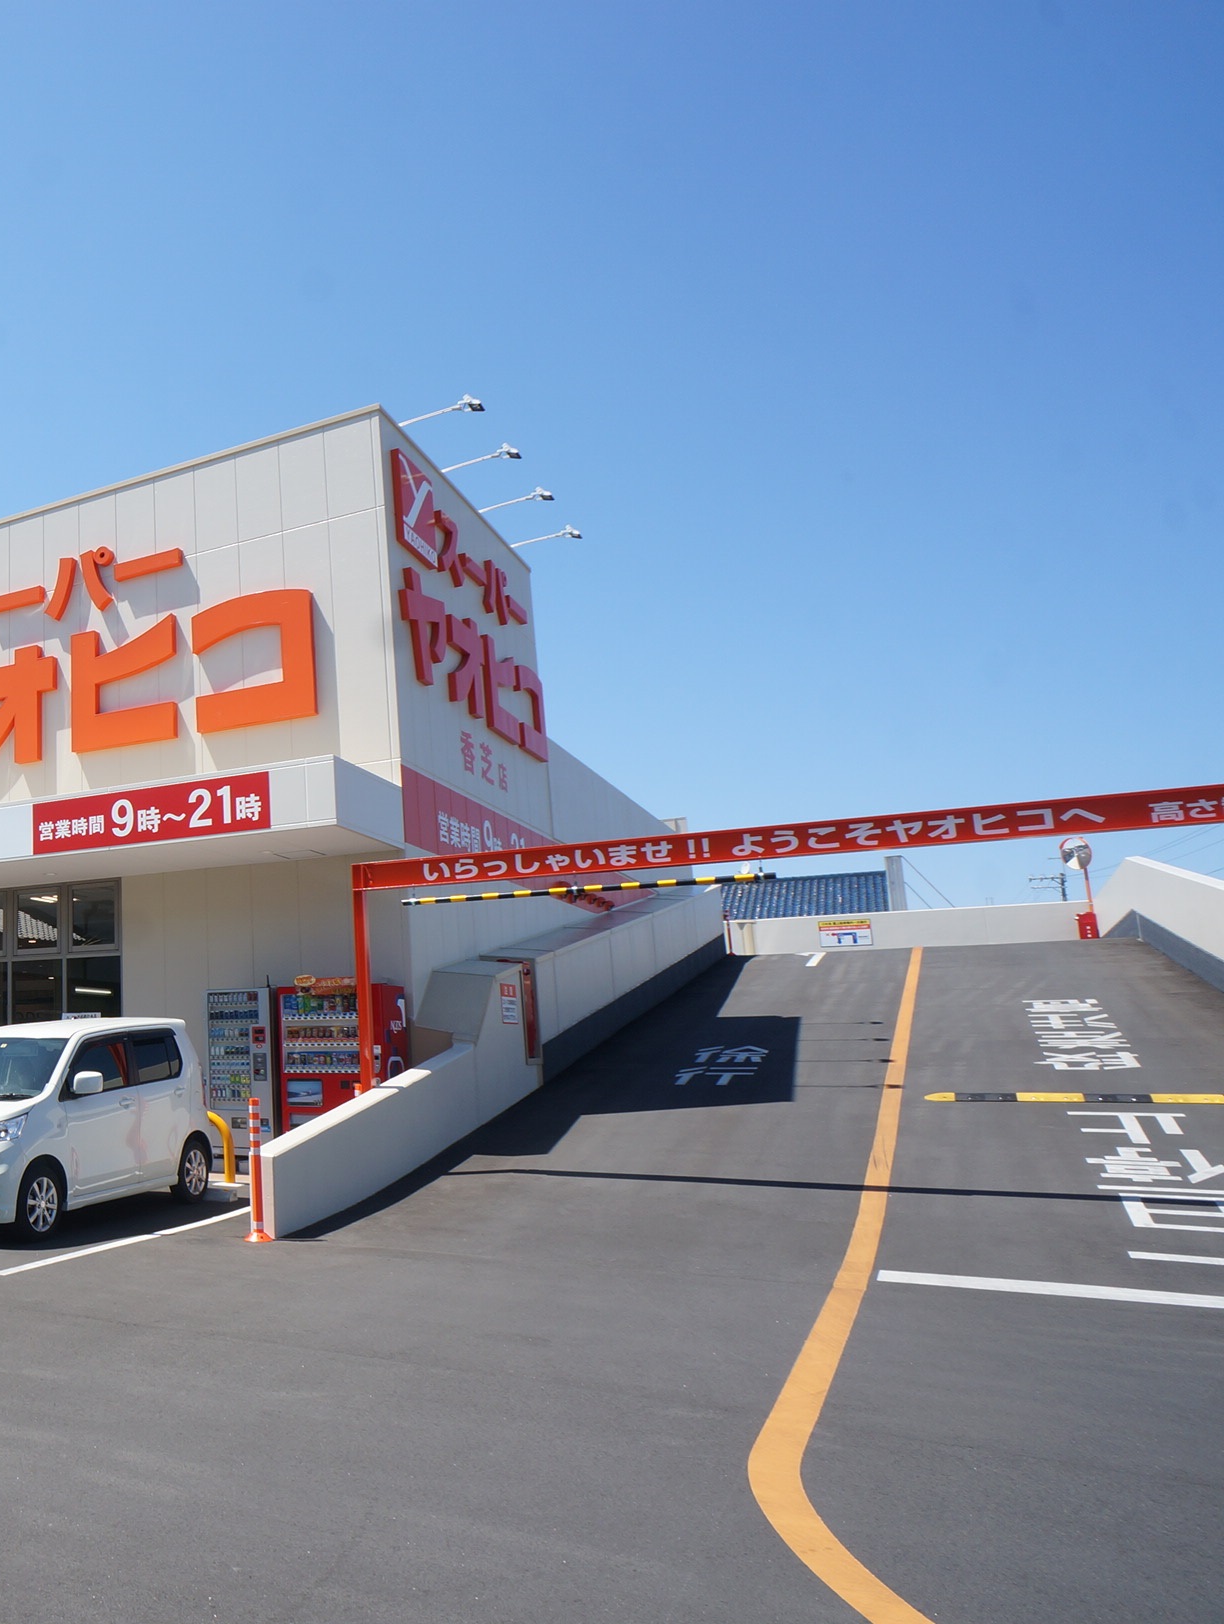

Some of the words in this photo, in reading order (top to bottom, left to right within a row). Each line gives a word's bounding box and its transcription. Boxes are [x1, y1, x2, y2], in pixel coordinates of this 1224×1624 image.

[433, 509, 528, 626] スーパー
[398, 566, 548, 762] ヤオヒコ
[460, 731, 508, 793] 香芝店
[731, 807, 1106, 857] ようこそヤオヒコへ
[1148, 797, 1224, 823] 高さ
[674, 1045, 770, 1086] 徐行
